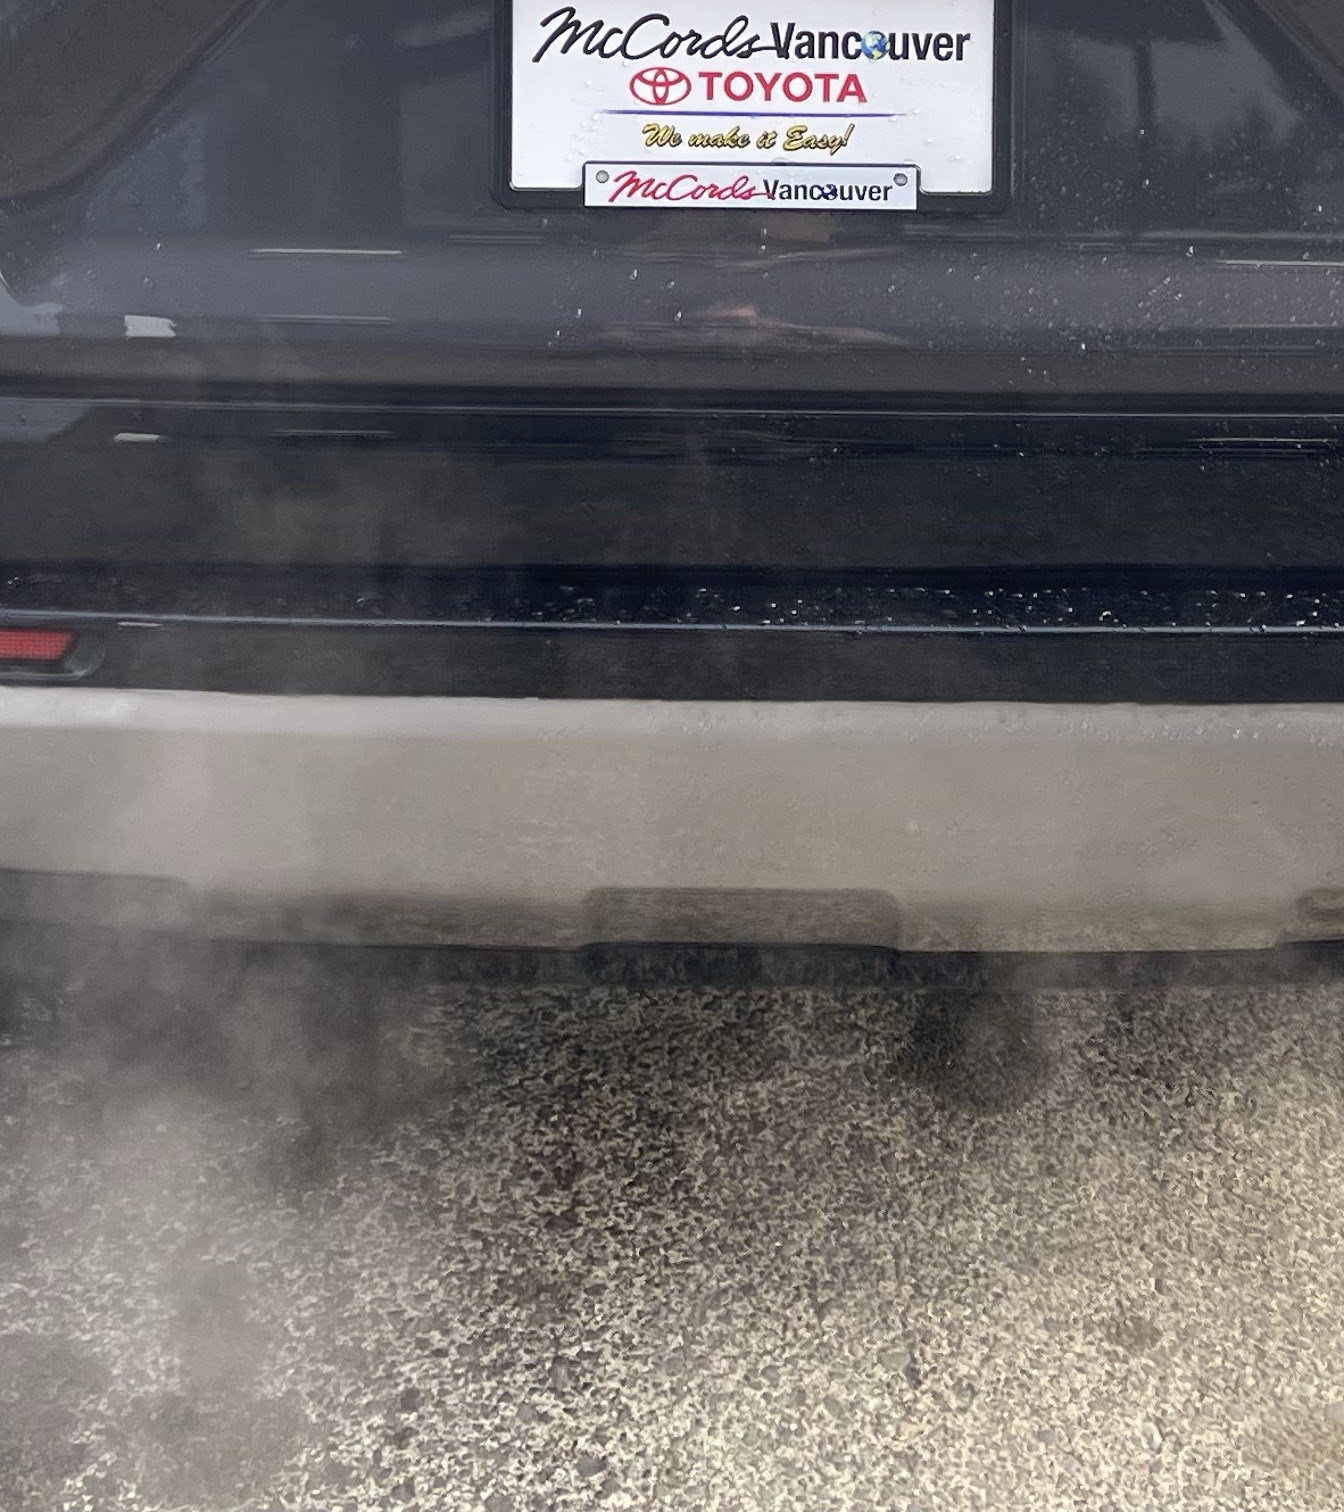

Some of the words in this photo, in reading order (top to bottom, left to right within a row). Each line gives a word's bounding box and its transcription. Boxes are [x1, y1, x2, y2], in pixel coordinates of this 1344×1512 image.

[532, 5, 776, 63] McCords
[698, 71, 867, 103] TOYOTA
[642, 122, 683, 148] We
[688, 124, 751, 149] make
[755, 129, 778, 149] it
[782, 122, 855, 156] Easy!
[608, 169, 768, 203] McCords
